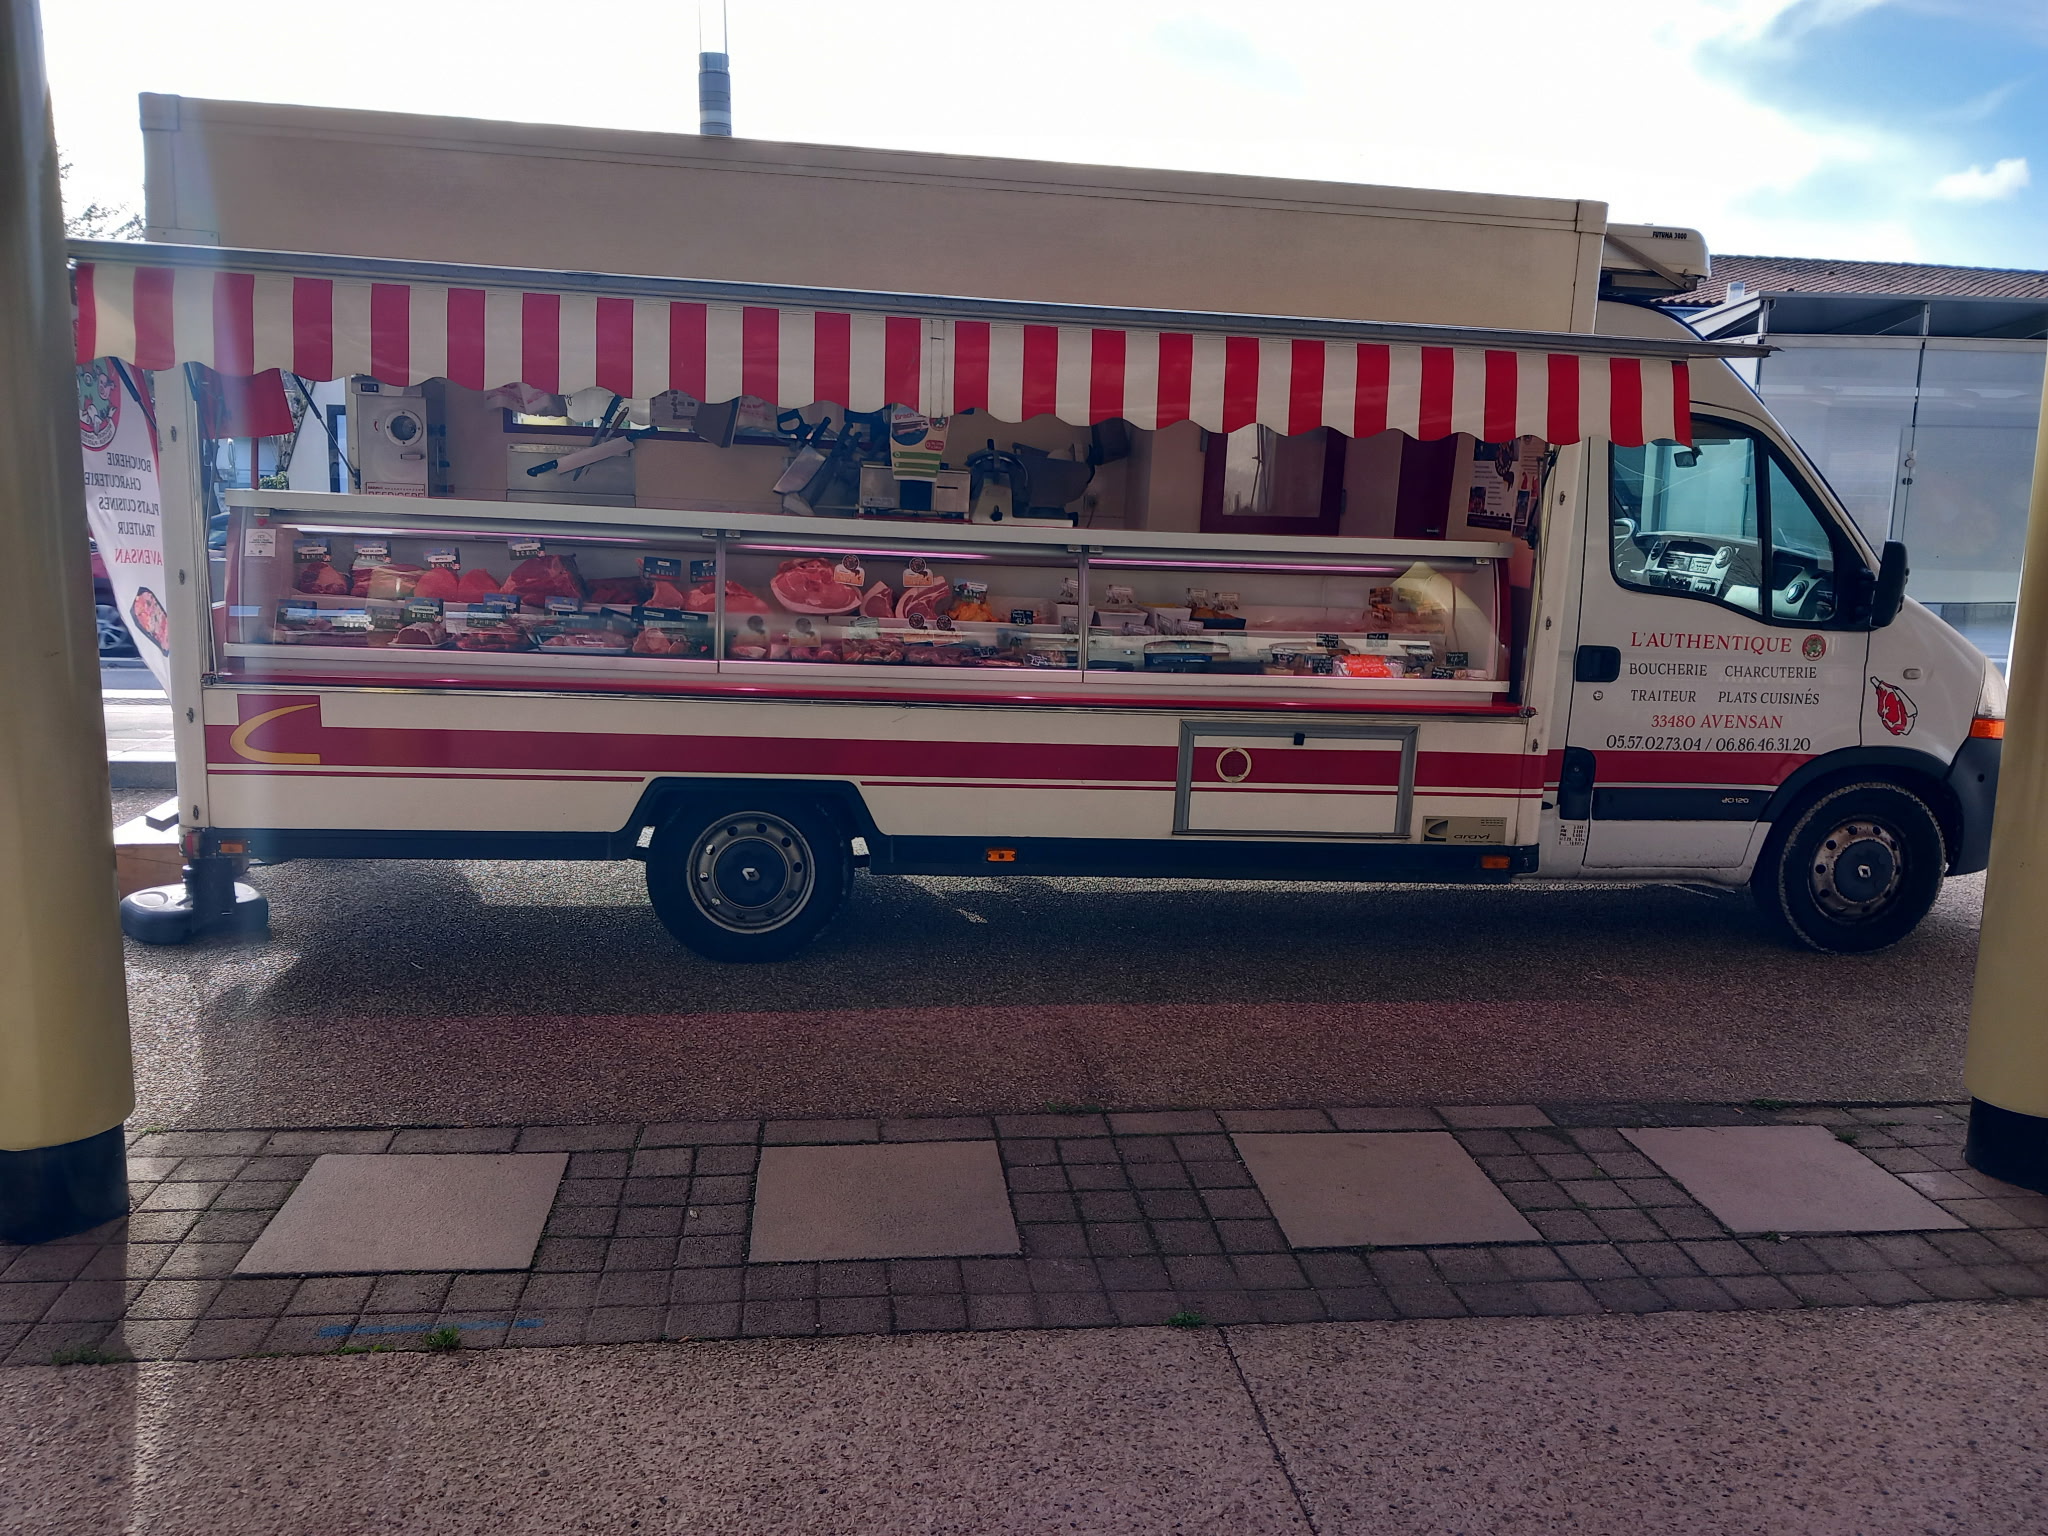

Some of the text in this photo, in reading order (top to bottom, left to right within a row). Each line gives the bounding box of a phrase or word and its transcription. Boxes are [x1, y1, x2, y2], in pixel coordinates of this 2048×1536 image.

[1630, 632, 1793, 655] L'AUTHENTIQUE
[1628, 662, 1818, 679] BOUCHERIE CHARCUTERIE
[1630, 687, 1820, 706] TRAITEUR PLATS CUISINÉS
[1650, 714, 1784, 730] 33480 AVENSAN
[1605, 734, 1702, 752] 05.57.02.73.04
[1715, 736, 1812, 752] 06.86.46.31.20
